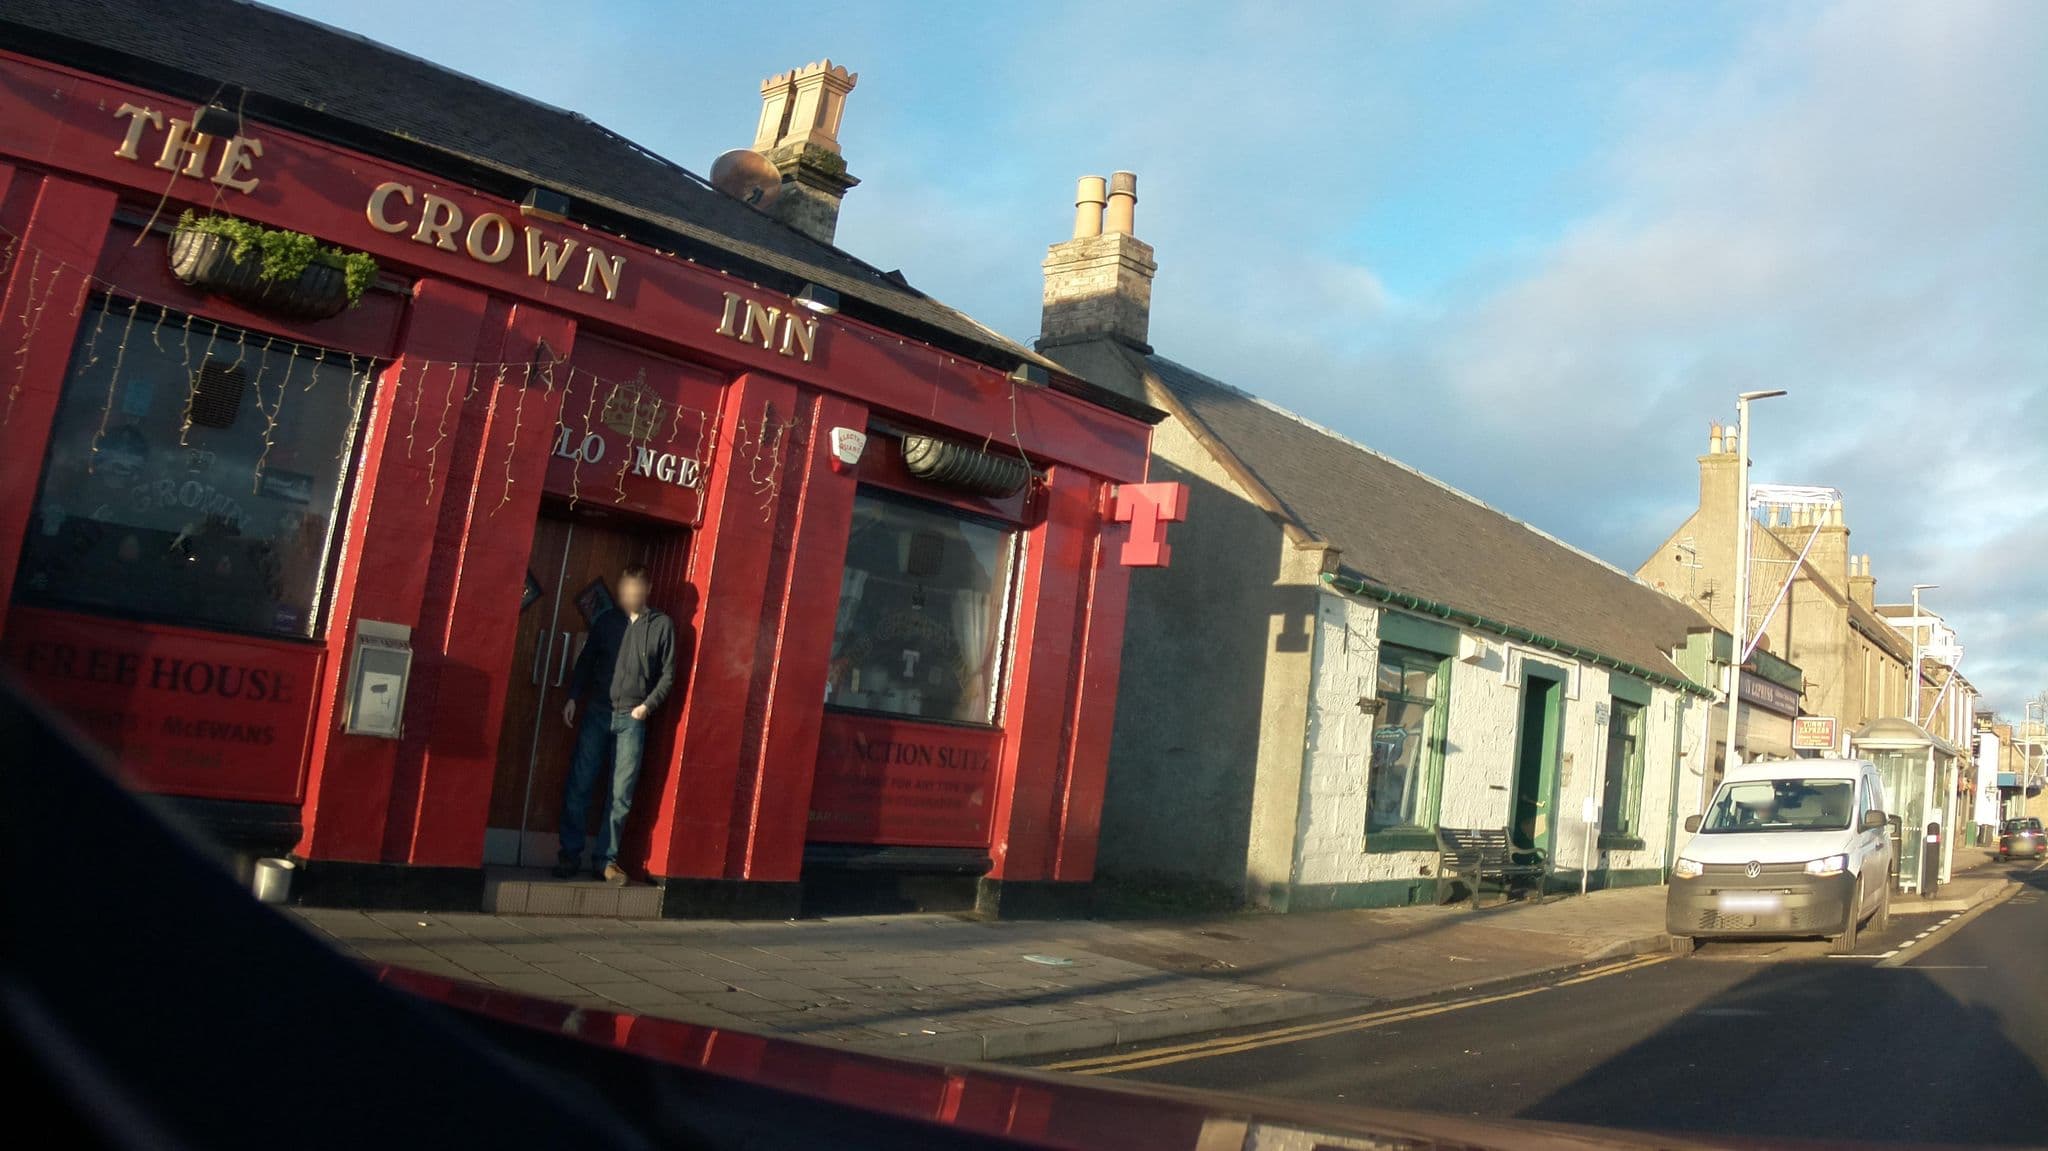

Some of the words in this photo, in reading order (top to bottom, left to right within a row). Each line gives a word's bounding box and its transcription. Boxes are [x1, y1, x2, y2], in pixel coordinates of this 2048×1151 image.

[113, 102, 264, 195] THE
[366, 182, 628, 300] CROWN
[715, 291, 820, 362] INN
[23, 641, 140, 688] FREE
[149, 655, 296, 703] HOUSE
[162, 715, 276, 746] McEWANS
